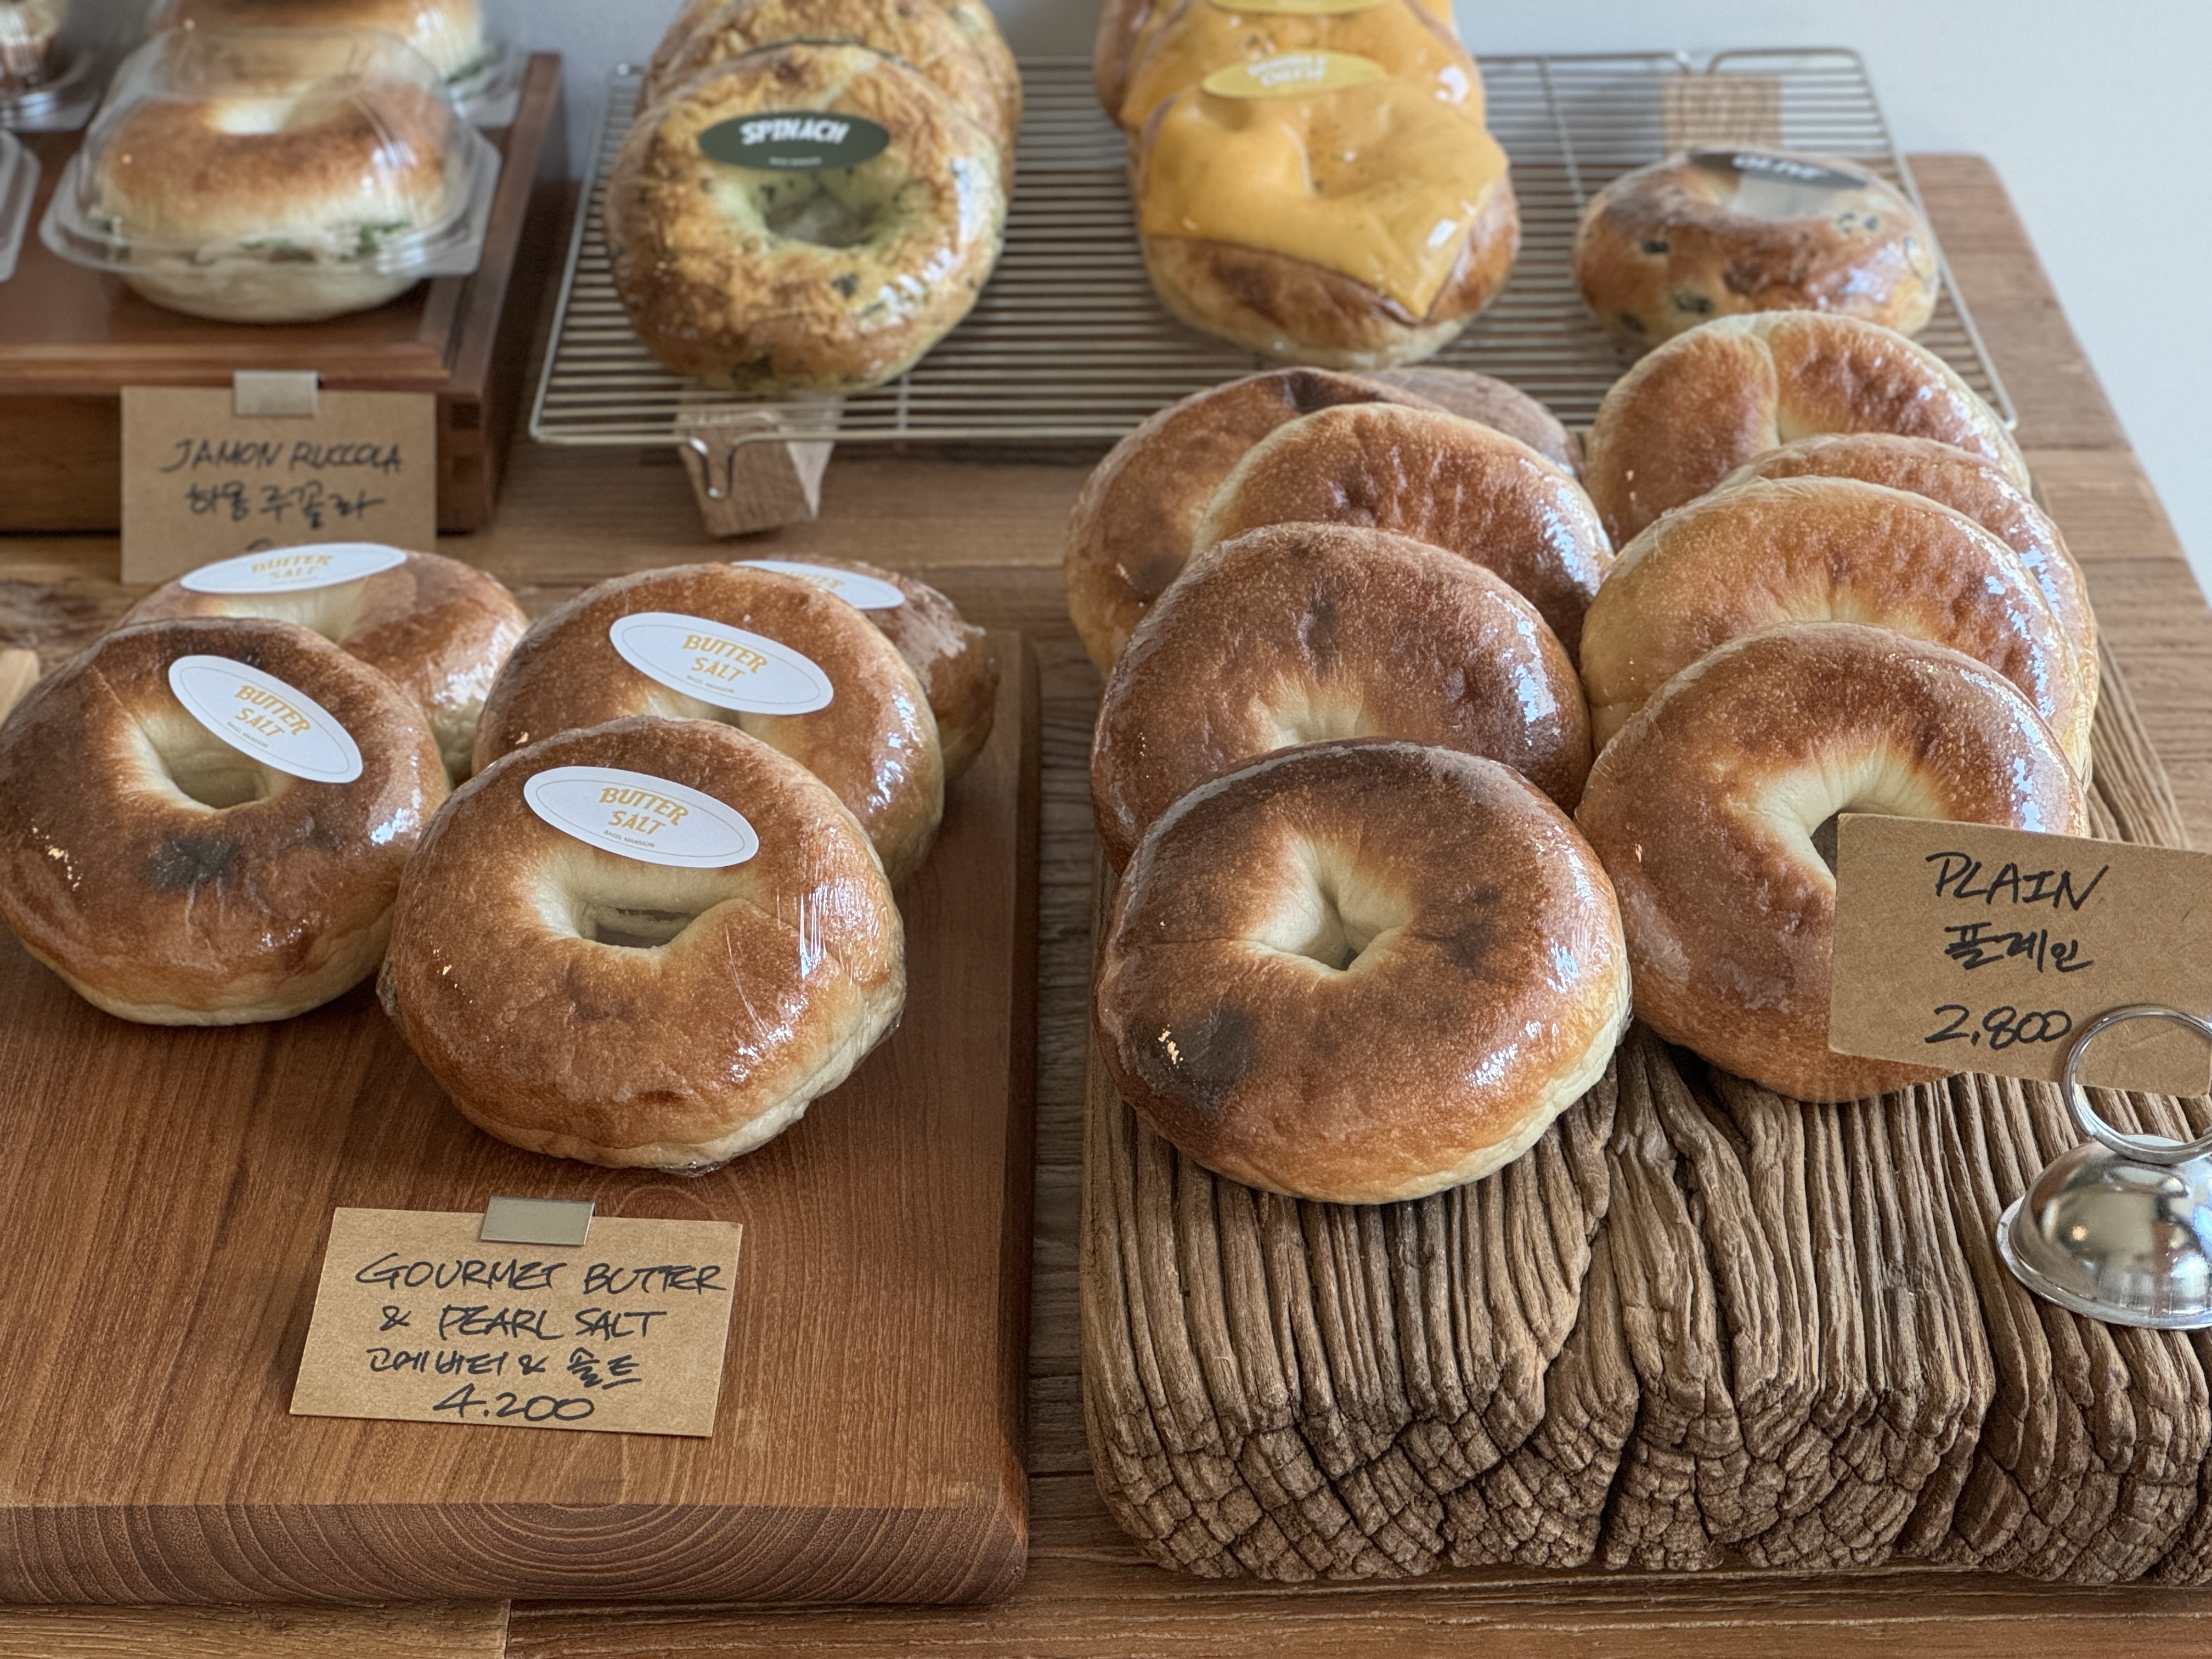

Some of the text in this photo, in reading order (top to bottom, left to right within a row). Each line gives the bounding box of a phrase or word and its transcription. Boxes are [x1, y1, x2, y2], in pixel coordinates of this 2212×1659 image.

[739, 117, 850, 145] SPINACH
[160, 439, 283, 472] JAMON
[185, 480, 249, 522] 하몽
[252, 555, 332, 573] BUTTER
[682, 634, 768, 675] BUTTER
[691, 657, 746, 682] SALT
[705, 682, 735, 694] MANSION
[234, 685, 311, 736] BUTTER
[234, 708, 285, 737] SALT
[599, 787, 689, 826] BUTTER
[608, 810, 666, 835] SALT
[604, 830, 654, 848] BAGEL MANSION
[1925, 851, 2109, 911] PLAIN
[1944, 922, 2094, 973] 플레인
[1925, 1004, 2072, 1050] 2,800
[354, 1252, 726, 1295] GOURMET BUTTER
[379, 1304, 667, 1341] & PEARL SALT
[518, 1354, 546, 1374] &
[567, 1347, 641, 1389] 솔트
[433, 1384, 595, 1421] 4.200
